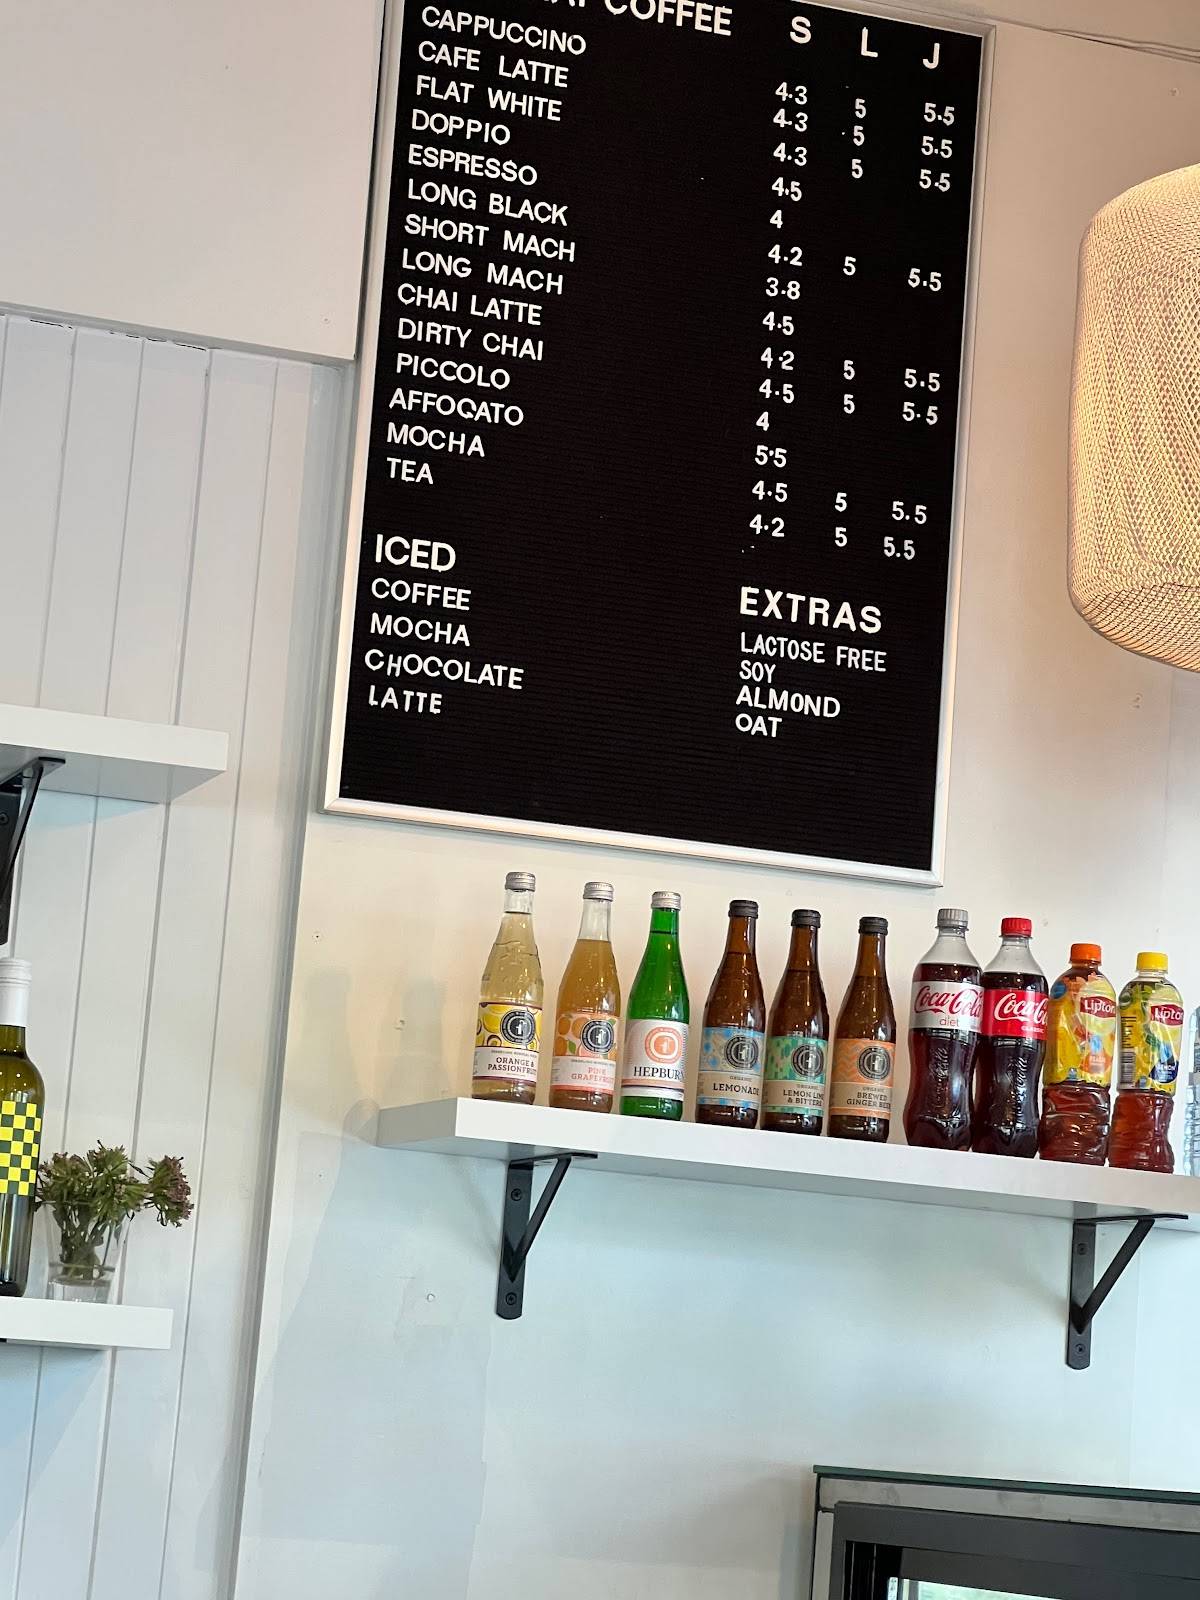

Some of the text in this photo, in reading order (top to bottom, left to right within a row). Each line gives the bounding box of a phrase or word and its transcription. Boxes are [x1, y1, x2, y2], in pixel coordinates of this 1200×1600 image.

[422, 6, 586, 55] CAPPUCCINO
[604, 0, 732, 36] COFFEE
[789, 16, 940, 69] S L J
[419, 41, 569, 88] CAFE LATTE
[416, 75, 562, 121] FLAT WHITE
[775, 82, 955, 126] 4.3 5 5.5
[411, 109, 510, 145] DOPPIO
[773, 108, 953, 159] 4.3 5 5.5
[408, 144, 537, 185] ESPRESSO
[773, 142, 951, 192] 4.3 5 5.5
[408, 178, 568, 226] LONG BLACK
[771, 177, 803, 202] 4.5
[405, 214, 575, 263] SHORT MACH
[770, 210, 783, 229] 4
[403, 248, 563, 295] LONG MACH
[767, 244, 942, 292] 4.2 5 5.5
[397, 283, 542, 326] CHAI LATTE
[765, 277, 801, 300] 3.8
[398, 318, 543, 361] DIRTY CHAI
[762, 311, 795, 336] 4.5
[397, 353, 510, 389] PICCOLO
[760, 347, 941, 392] 4.2 5 5.5
[758, 378, 938, 426] 4.5 5 5.5
[386, 422, 485, 457] MOCHA
[756, 412, 769, 432] 4
[387, 457, 433, 485] TEA
[751, 480, 927, 525] 4.5 5 5.5
[376, 534, 456, 572] ICED
[749, 514, 916, 561] 4.2 5 5.5
[372, 578, 471, 611] COFFEE
[740, 587, 882, 634] EXTRAS
[371, 613, 470, 647] MOCHA
[365, 649, 525, 690] CHOCOLATE
[740, 632, 887, 672] LACTOSE FREE
[739, 660, 777, 684] SOY
[369, 685, 443, 714] LATTE
[736, 685, 840, 718] ALMOND
[736, 714, 783, 738] OAT
[939, 1017, 960, 1027] diet
[496, 1056, 530, 1067] ORANGE
[783, 1089, 812, 1099] LEMON
[846, 1098, 876, 1107] GINGER
[857, 1092, 887, 1101] BREWED
